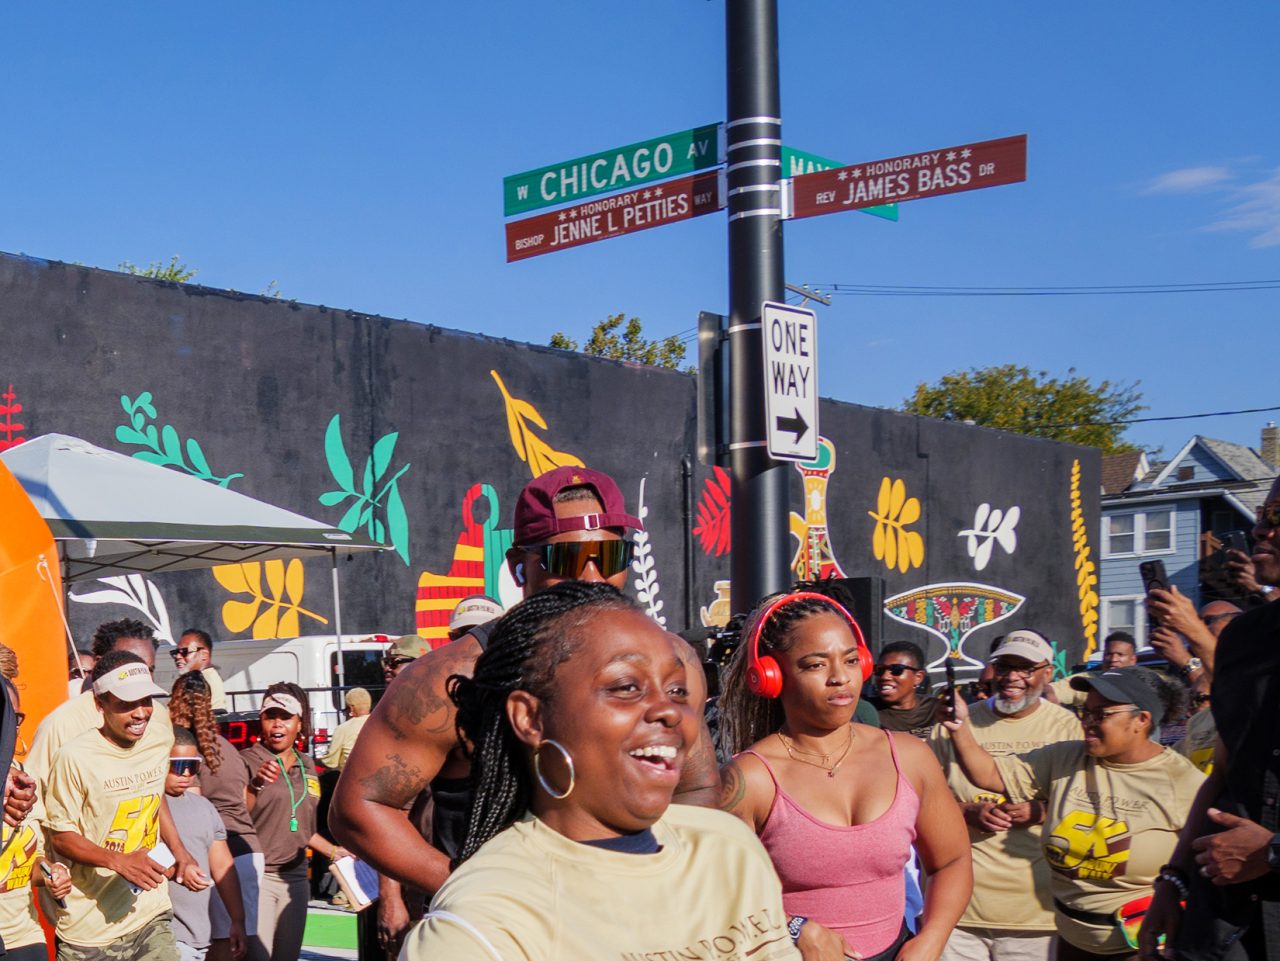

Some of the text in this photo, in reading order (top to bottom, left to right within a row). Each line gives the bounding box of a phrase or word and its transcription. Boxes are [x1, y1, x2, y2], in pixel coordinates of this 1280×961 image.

[516, 139, 709, 201] W CHICAGO AV
[816, 161, 996, 205] REV JAMES BASS DR
[866, 152, 940, 177] HONORARY
[515, 191, 713, 251] BISHOP JENNE L PETTIES WAY
[580, 192, 638, 217] HONORARY
[772, 318, 809, 357] ONE
[772, 360, 810, 399] WAY
[103, 775, 133, 790] AUSTIN
[1044, 810, 1129, 870] 5K
